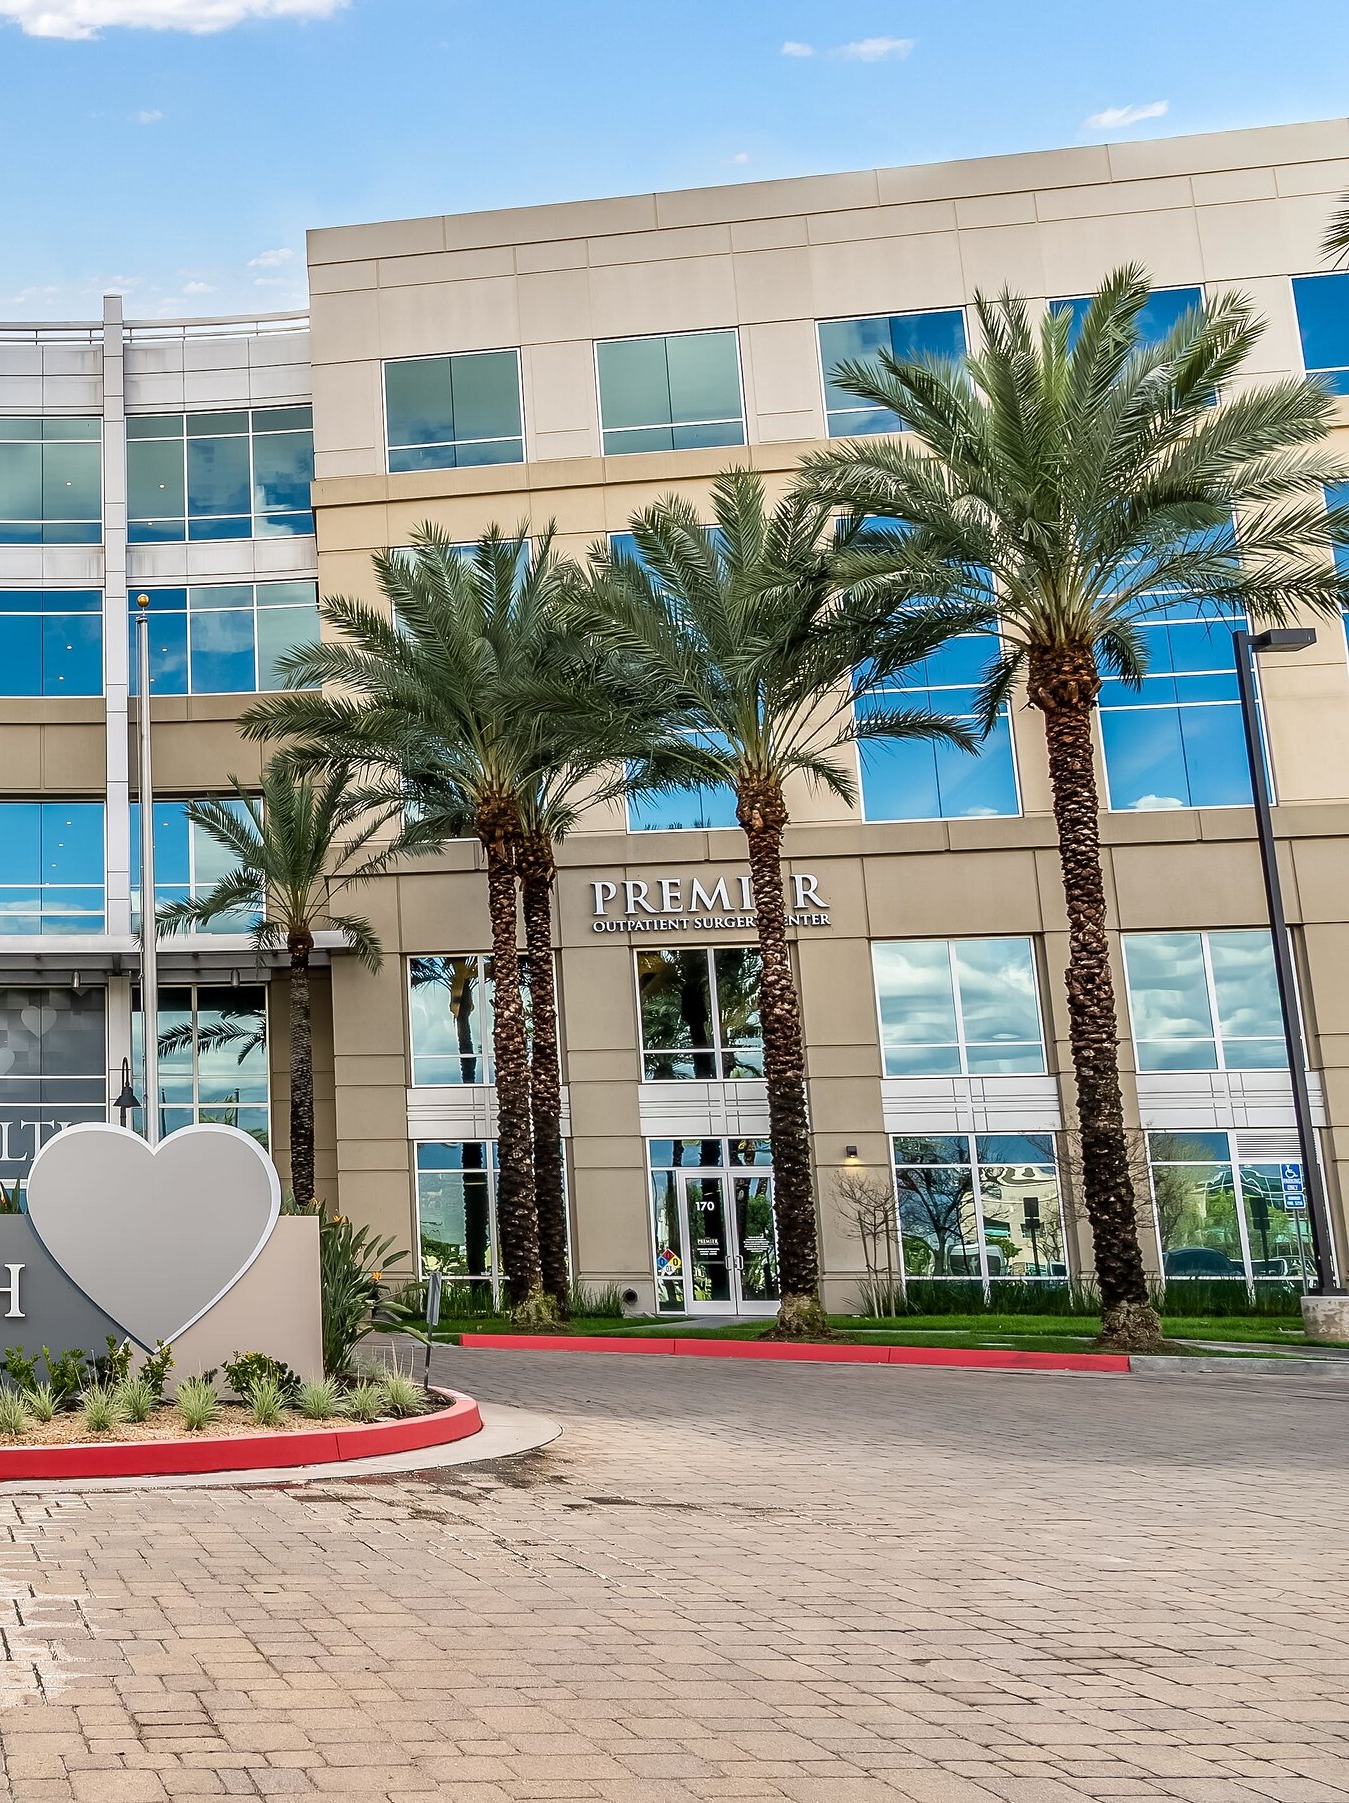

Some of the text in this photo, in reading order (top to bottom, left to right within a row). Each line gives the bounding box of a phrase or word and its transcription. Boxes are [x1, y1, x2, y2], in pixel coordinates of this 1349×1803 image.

[590, 874, 830, 915] PREMIR
[593, 913, 831, 932] OUTPATIENT SURGER NTER
[695, 1201, 715, 1211] 170
